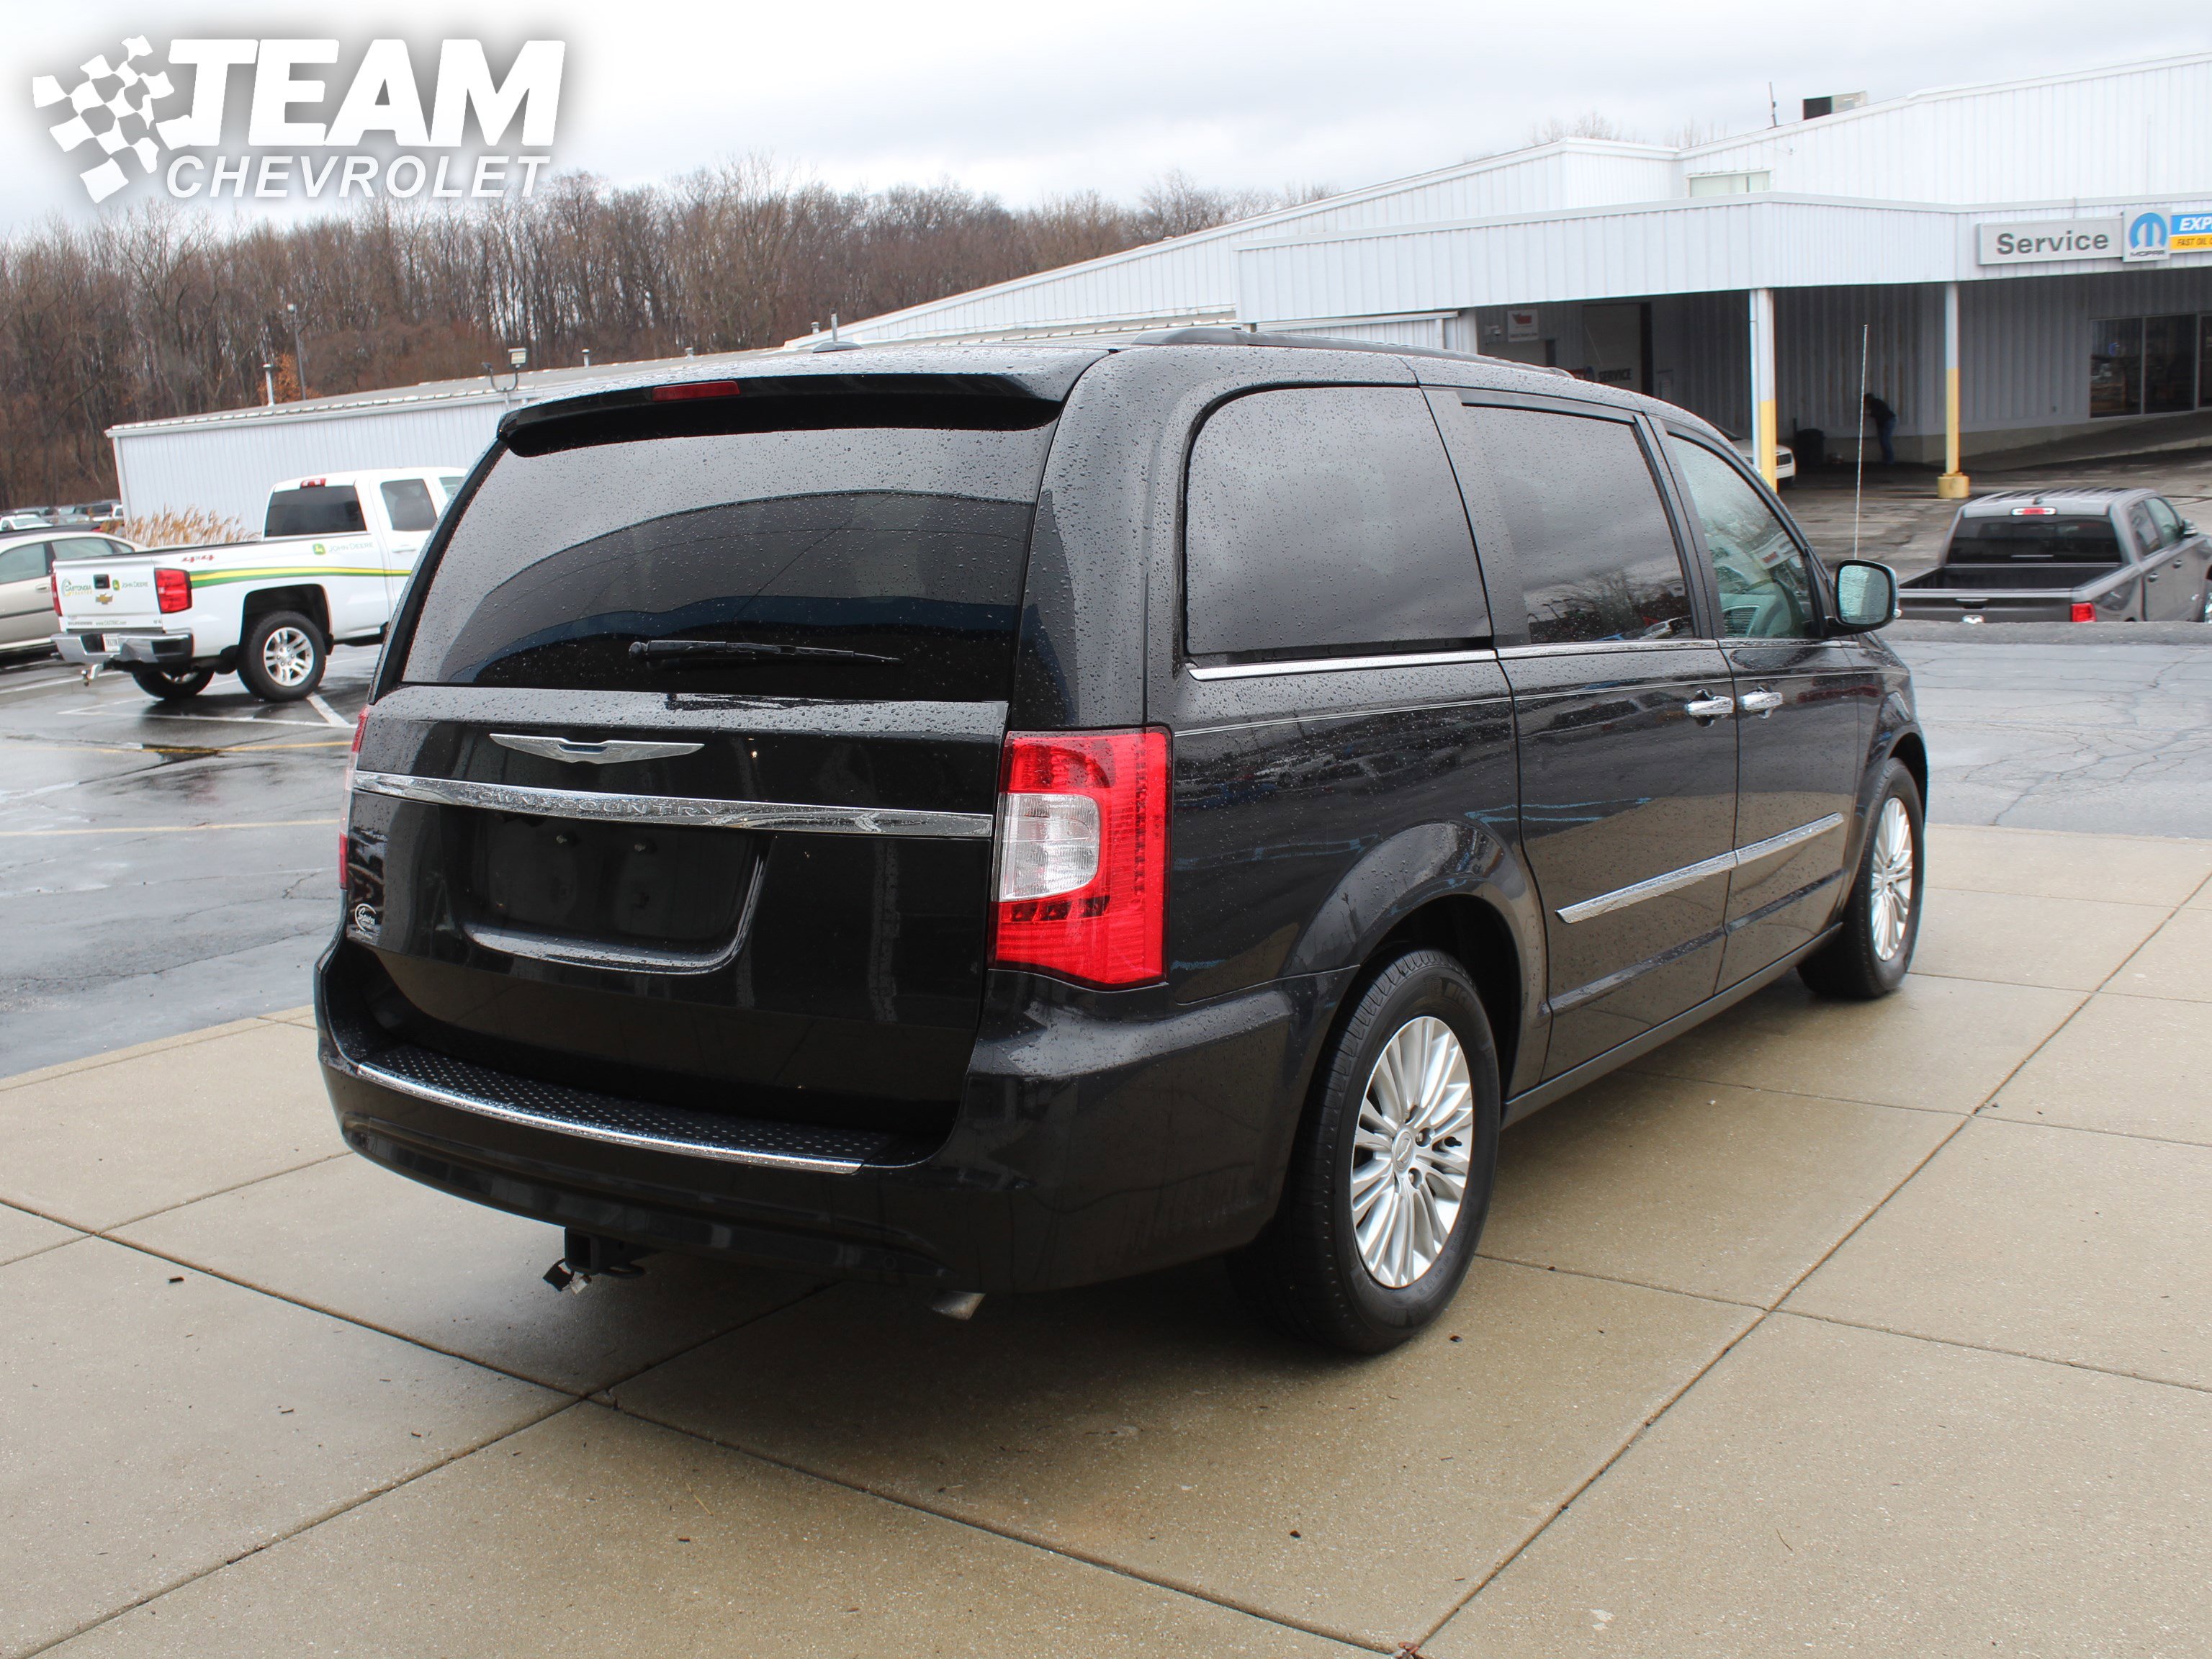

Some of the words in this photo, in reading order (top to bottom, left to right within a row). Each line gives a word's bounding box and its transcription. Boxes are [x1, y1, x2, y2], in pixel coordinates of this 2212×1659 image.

[2178, 217, 2212, 232] EXP
[1997, 230, 2109, 254] Service
[349, 542, 374, 551] DEERE
[463, 787, 536, 805] TOWN
[557, 799, 720, 817] COUNTRY
